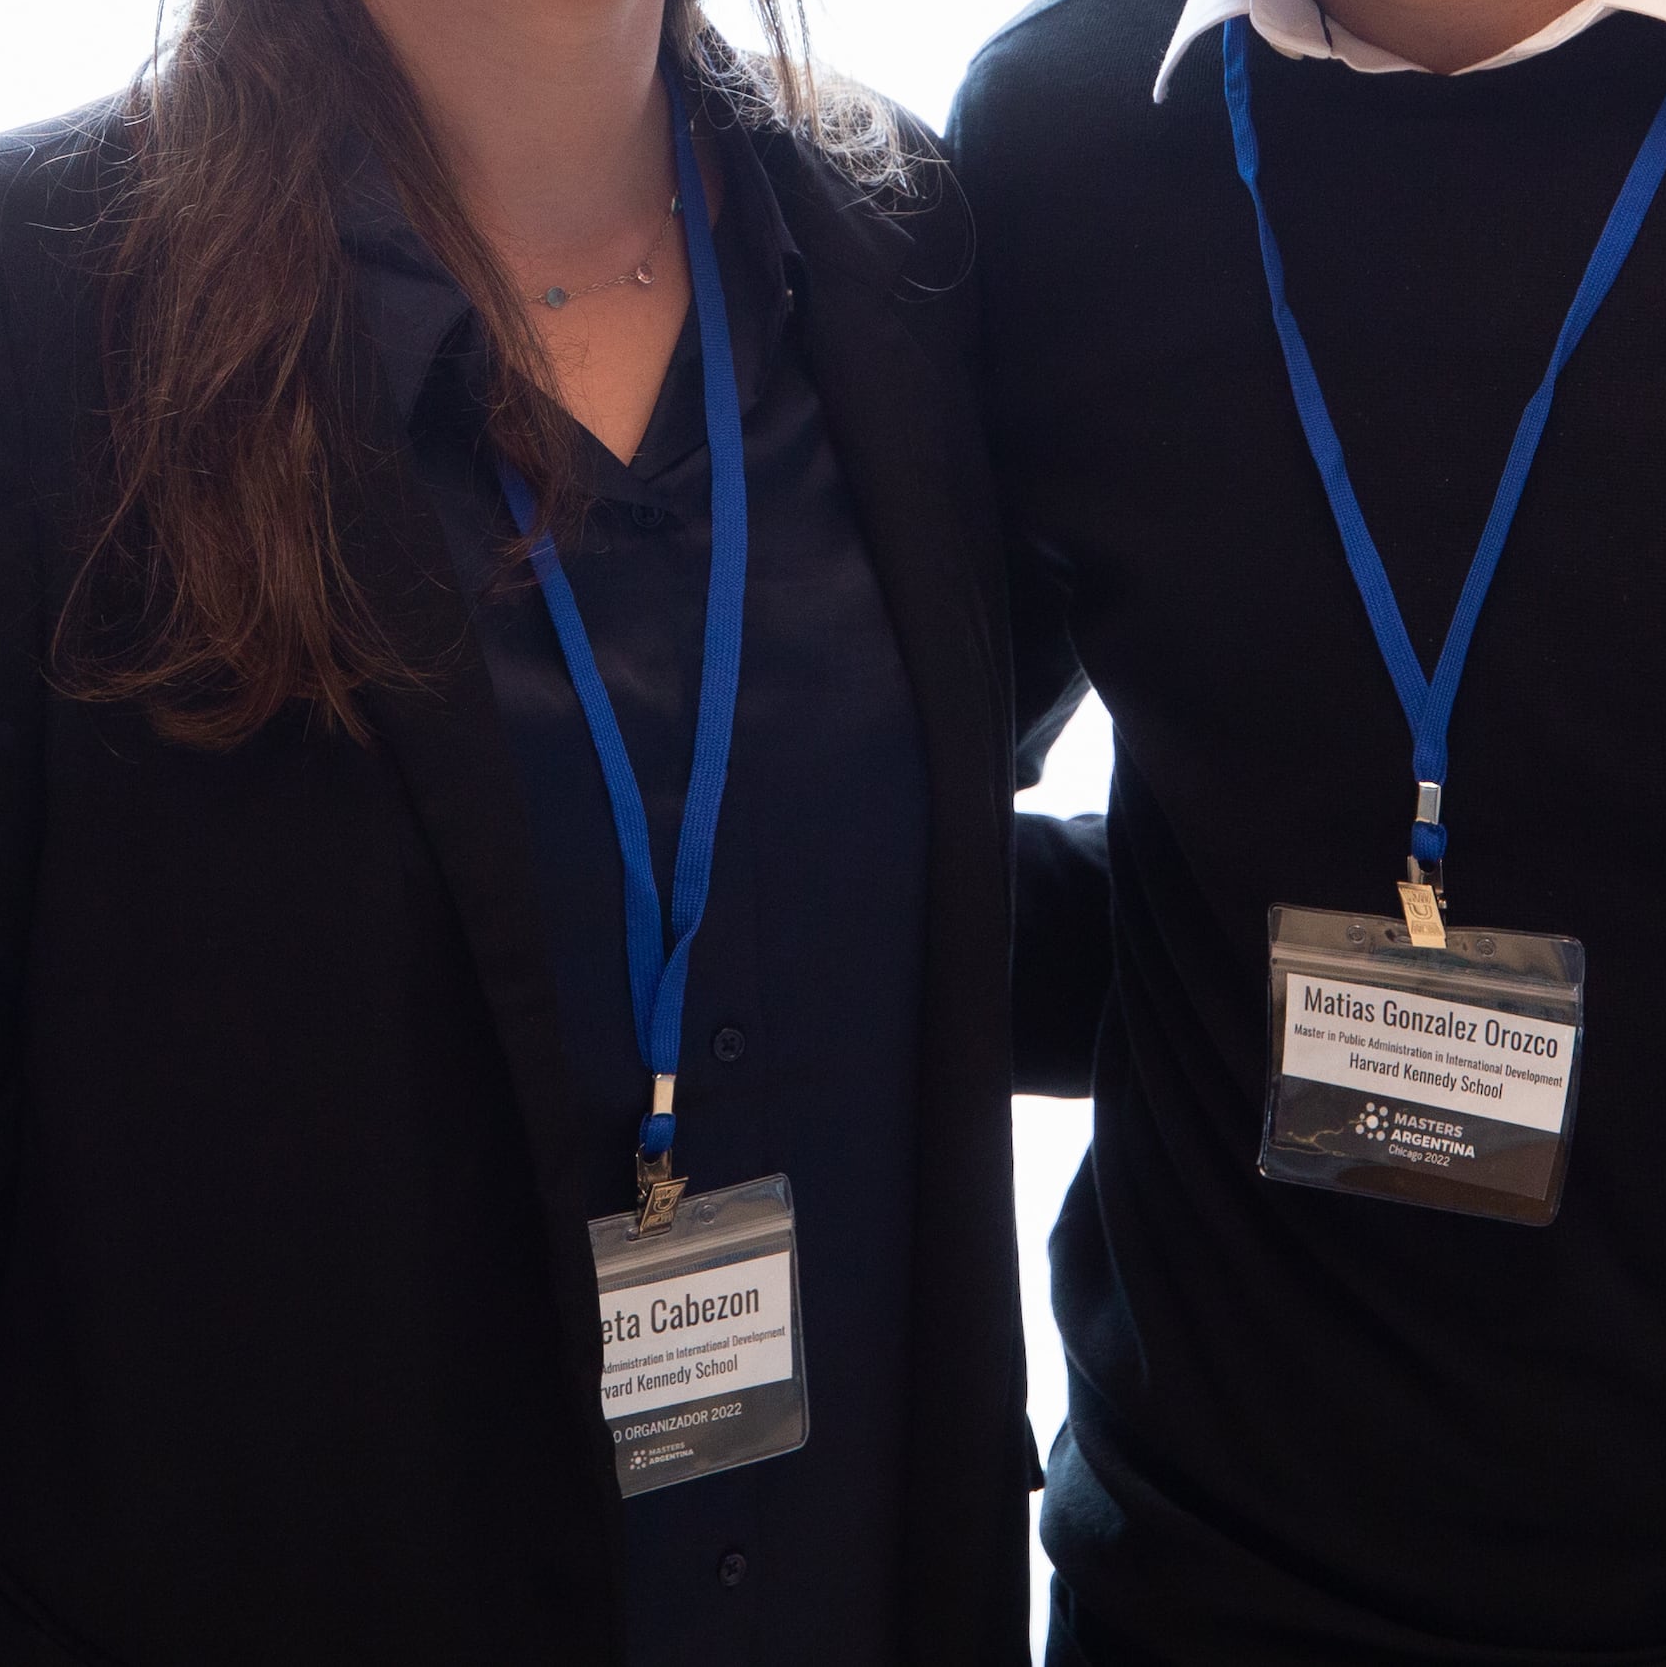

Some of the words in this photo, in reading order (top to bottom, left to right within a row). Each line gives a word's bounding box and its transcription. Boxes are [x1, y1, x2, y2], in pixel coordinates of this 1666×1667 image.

[1304, 986, 1375, 1022] Matias
[1383, 1001, 1476, 1042] Gonzalez
[1485, 1020, 1558, 1058] Orozco
[1294, 1024, 1325, 1041] Master
[1328, 1029, 1336, 1042] in
[1339, 1031, 1366, 1048] Public
[1368, 1037, 1432, 1061] Administration
[1435, 1051, 1443, 1063] in
[1446, 1053, 1502, 1075] International
[1505, 1064, 1562, 1088] Development
[1349, 1053, 1399, 1078] Harvard
[1404, 1065, 1456, 1092] Kennedy
[1461, 1075, 1503, 1099] School
[1390, 1130, 1475, 1158] ARGENTINA
[1394, 1113, 1463, 1138] MASTERS
[1389, 1144, 1423, 1162] Chicago
[1425, 1153, 1450, 1166] 2022
[651, 1288, 759, 1333] Cabezon
[666, 1350, 674, 1361] in
[676, 1337, 730, 1359] International
[732, 1326, 785, 1347] Development
[637, 1366, 691, 1392] Kennedy
[695, 1354, 738, 1379] School
[625, 1410, 708, 1440] ORGANIZADOR
[711, 1402, 742, 1421] 2022
